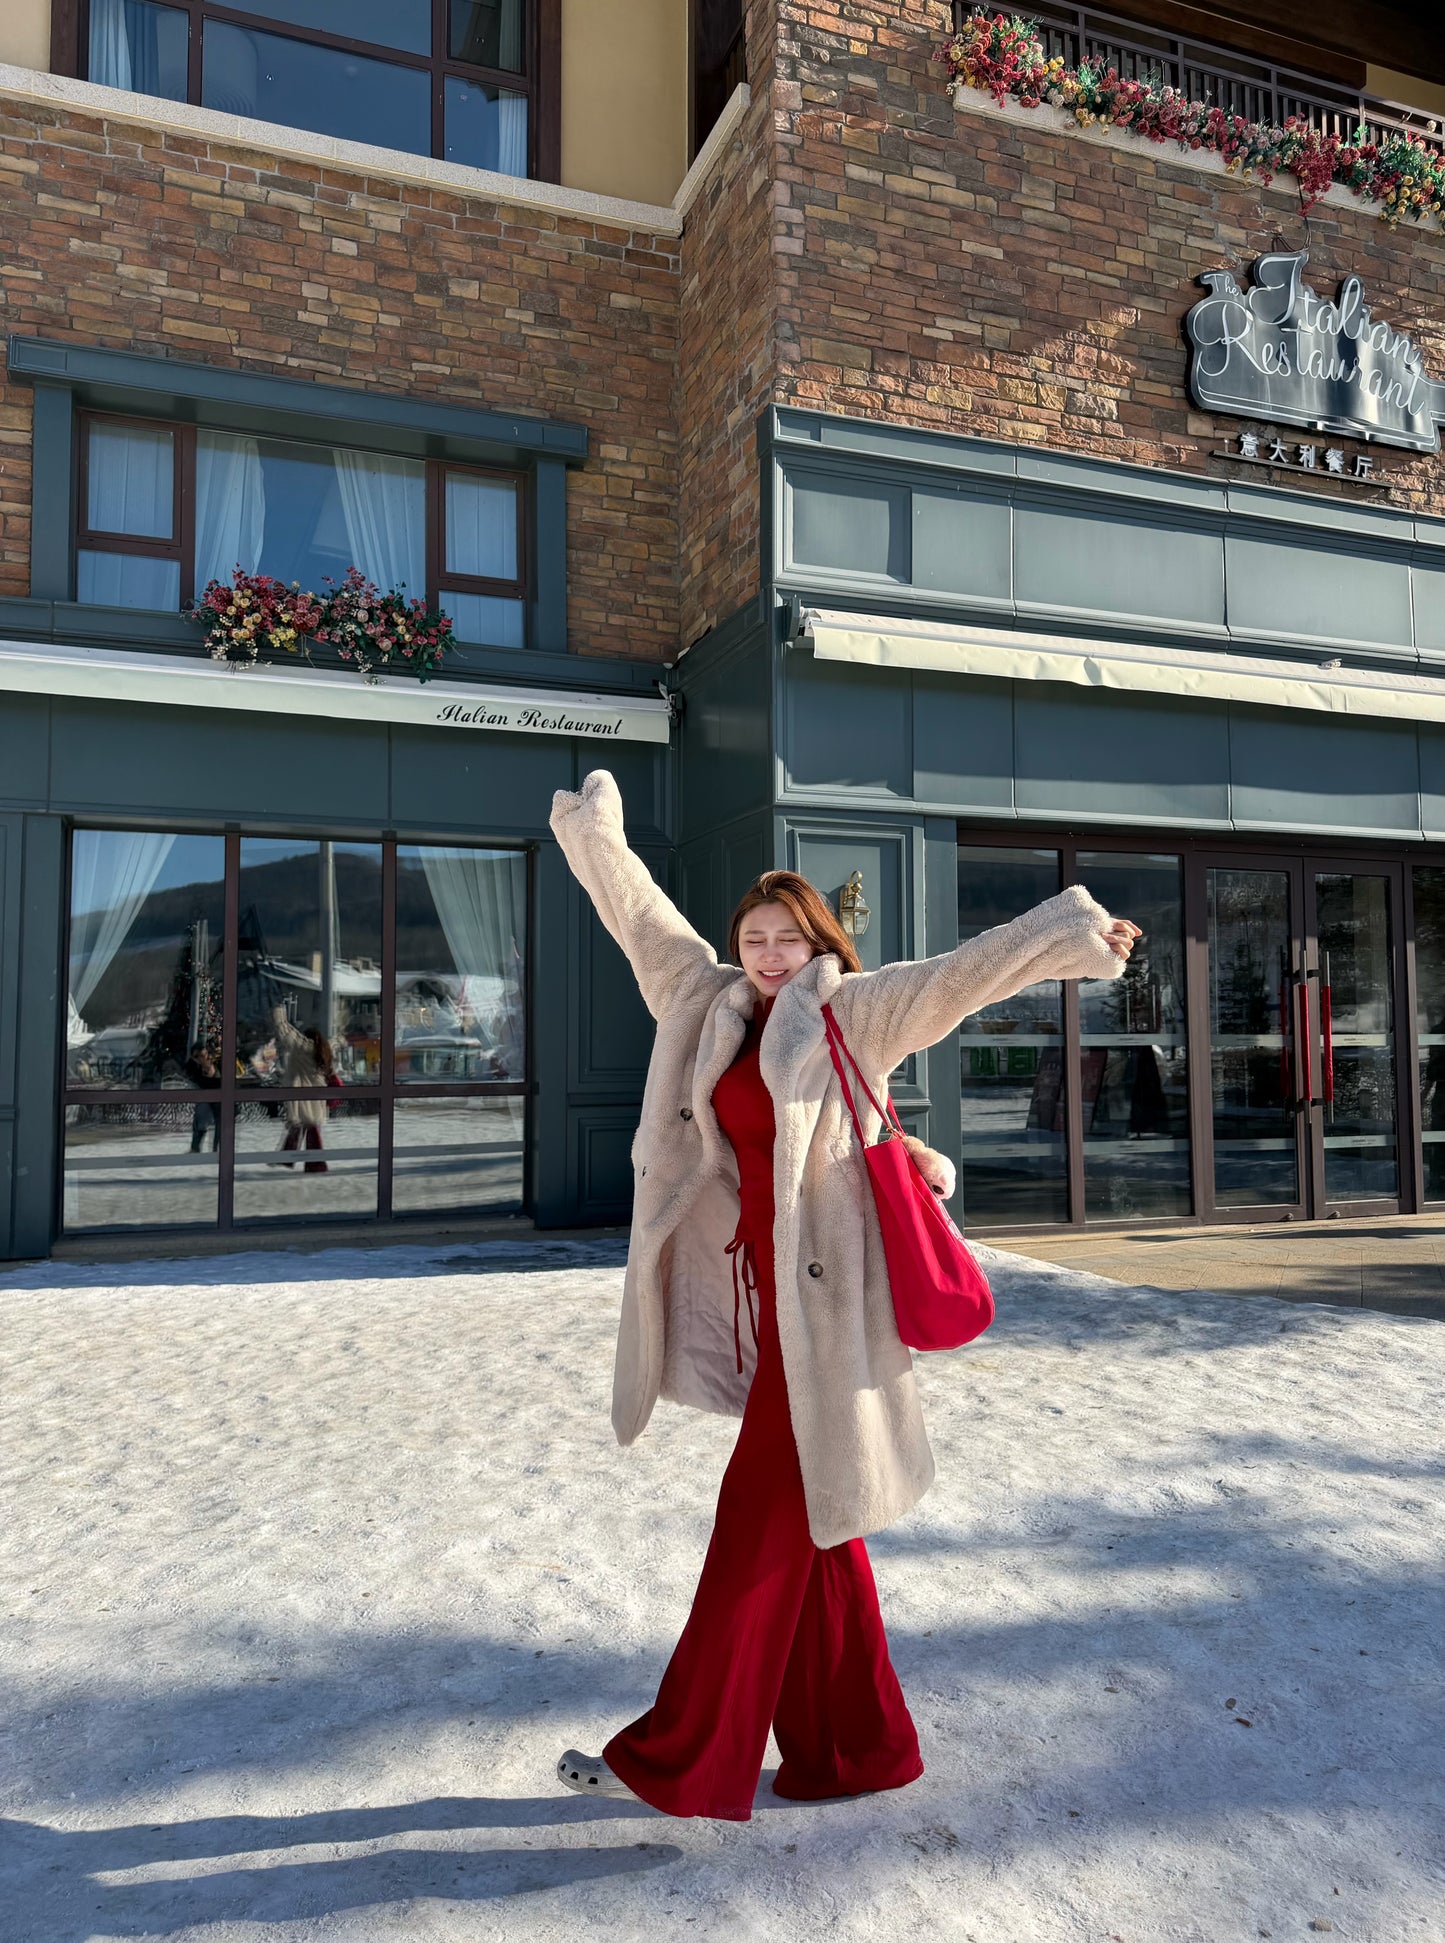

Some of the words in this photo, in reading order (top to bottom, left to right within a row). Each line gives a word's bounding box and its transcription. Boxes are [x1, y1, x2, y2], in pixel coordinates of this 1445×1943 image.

[1203, 273, 1240, 297] The
[1248, 256, 1421, 366] Italian
[1193, 300, 1425, 416] Restaurant
[1240, 432, 1374, 479] 意大利餐厅
[436, 703, 509, 726] Italian
[517, 708, 623, 735] Restaurant
